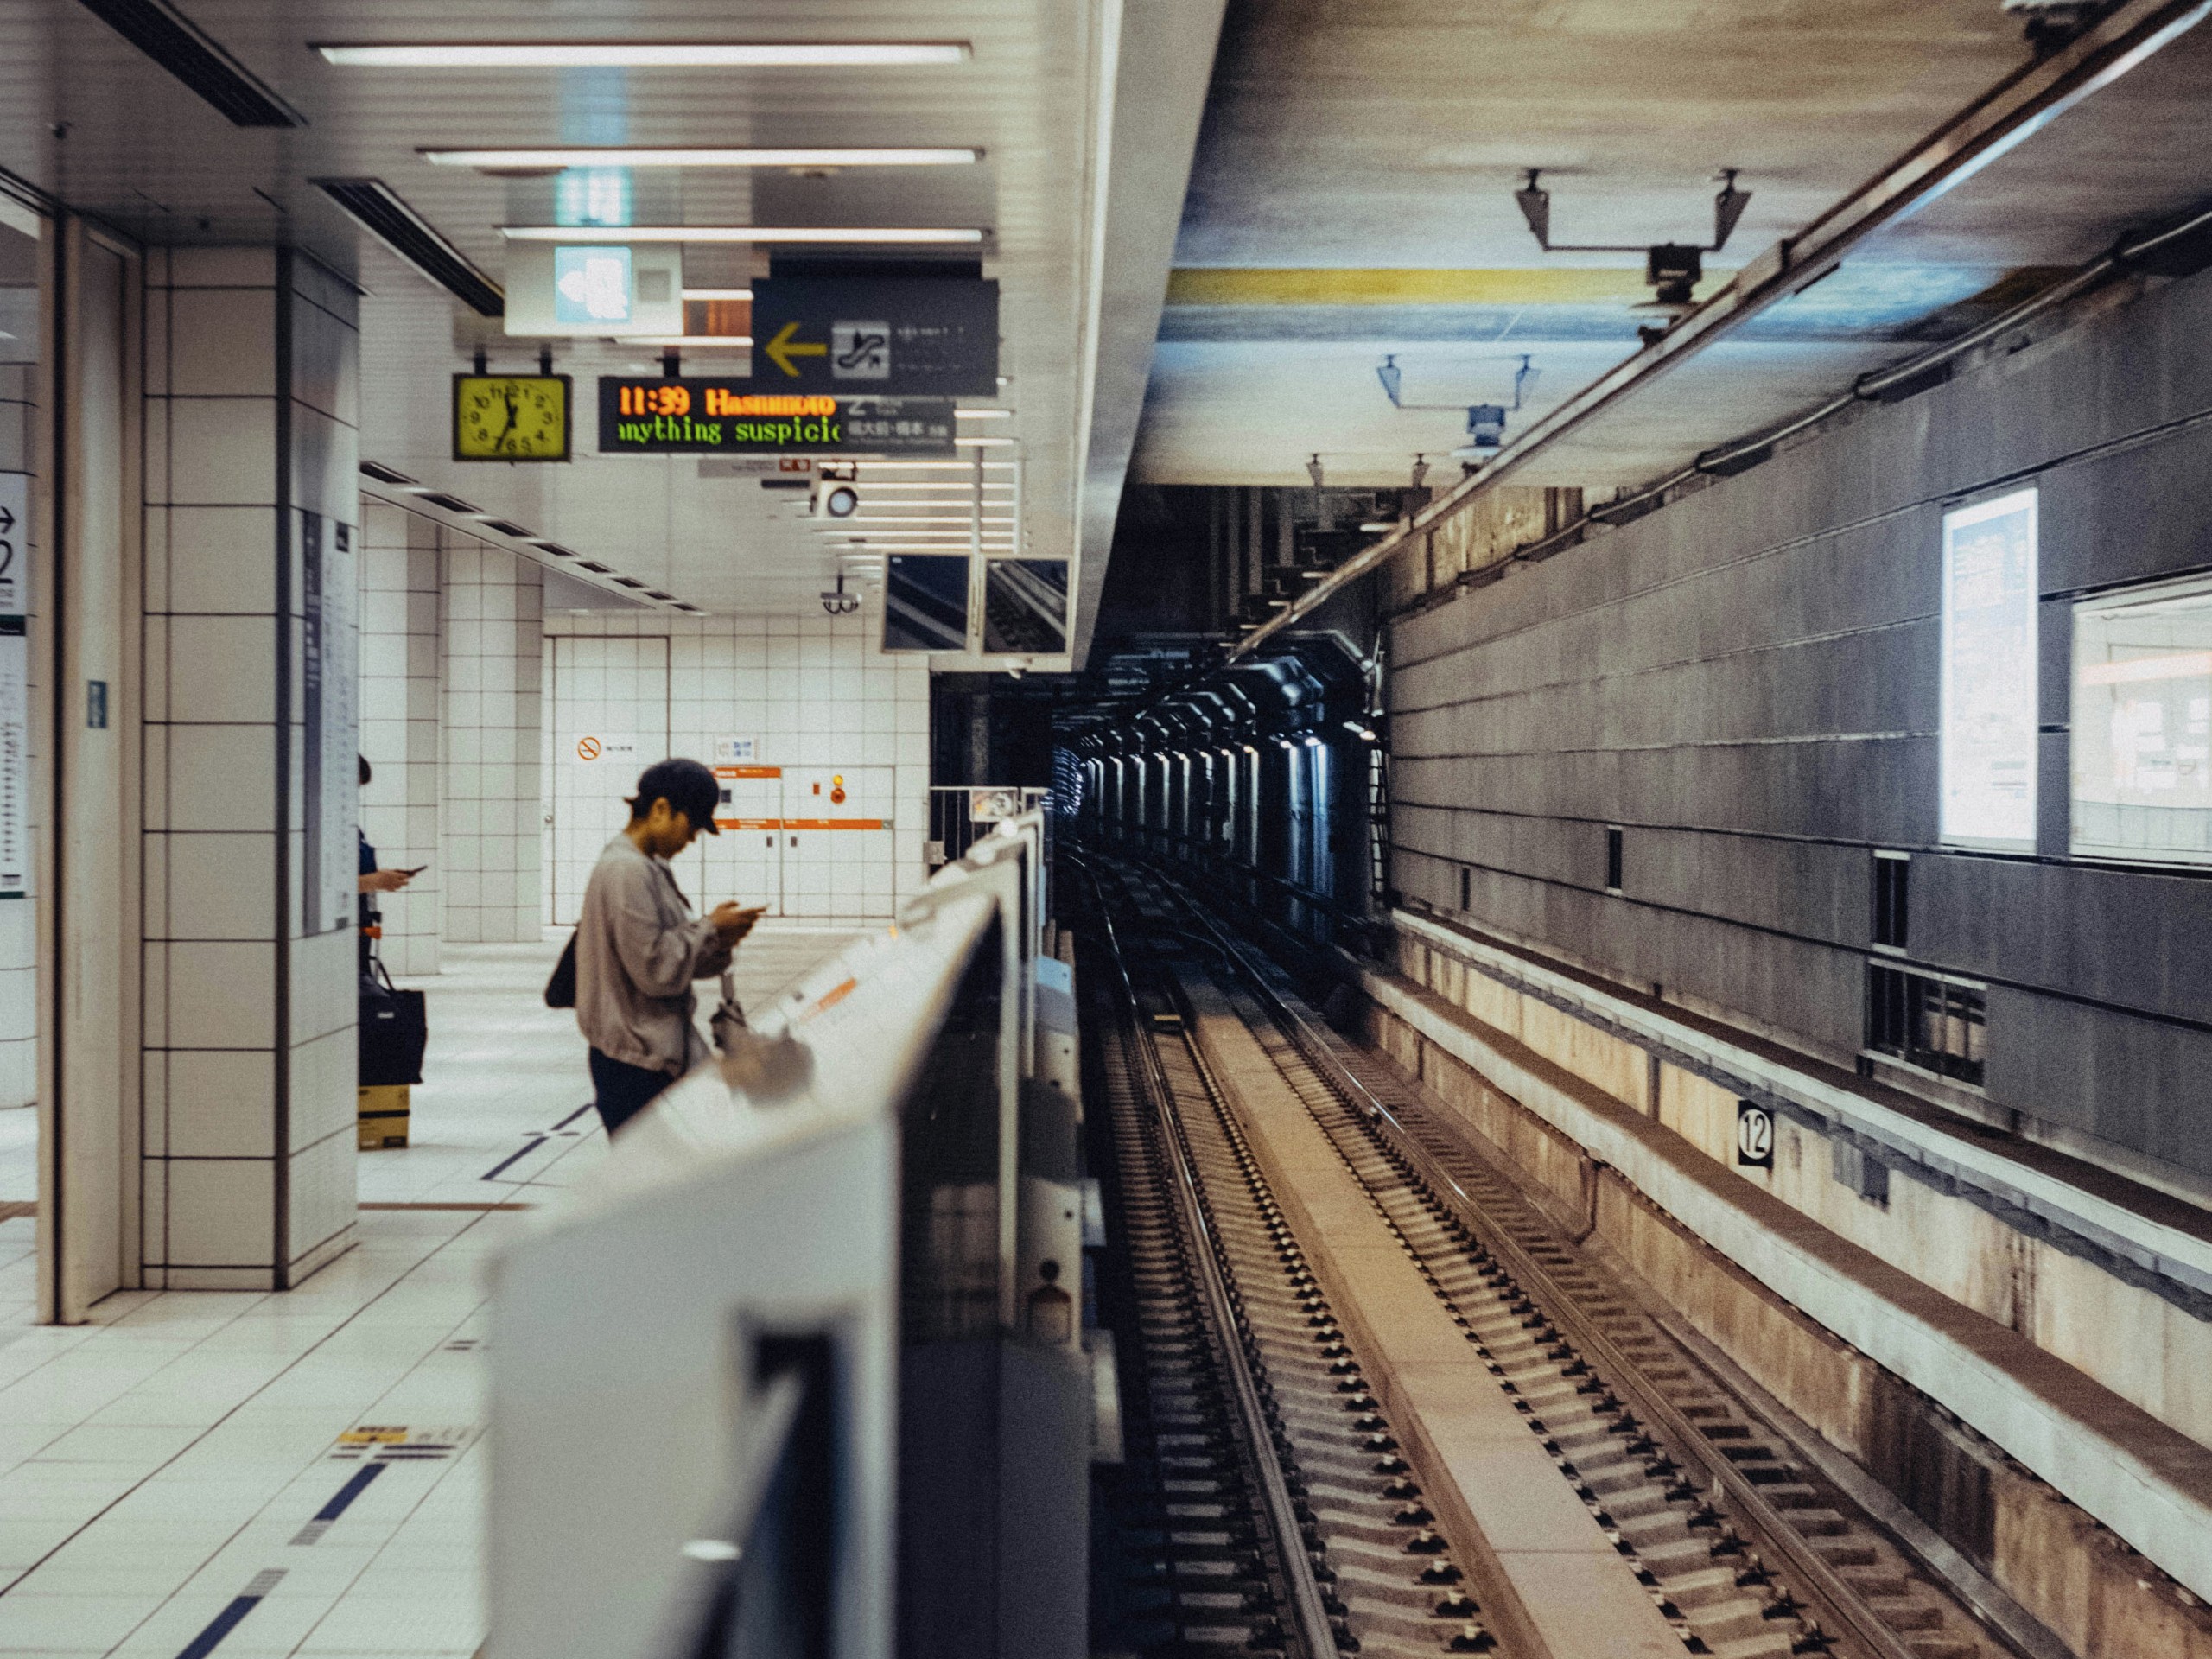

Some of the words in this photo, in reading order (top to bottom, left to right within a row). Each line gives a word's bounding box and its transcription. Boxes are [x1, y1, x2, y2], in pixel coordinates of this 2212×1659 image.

[534, 394, 546, 409] 2
[620, 385, 690, 416] 11:39
[469, 410, 481, 425] 9
[542, 410, 554, 426] 3
[506, 438, 518, 451] 6
[1744, 1113, 1767, 1154] 12
